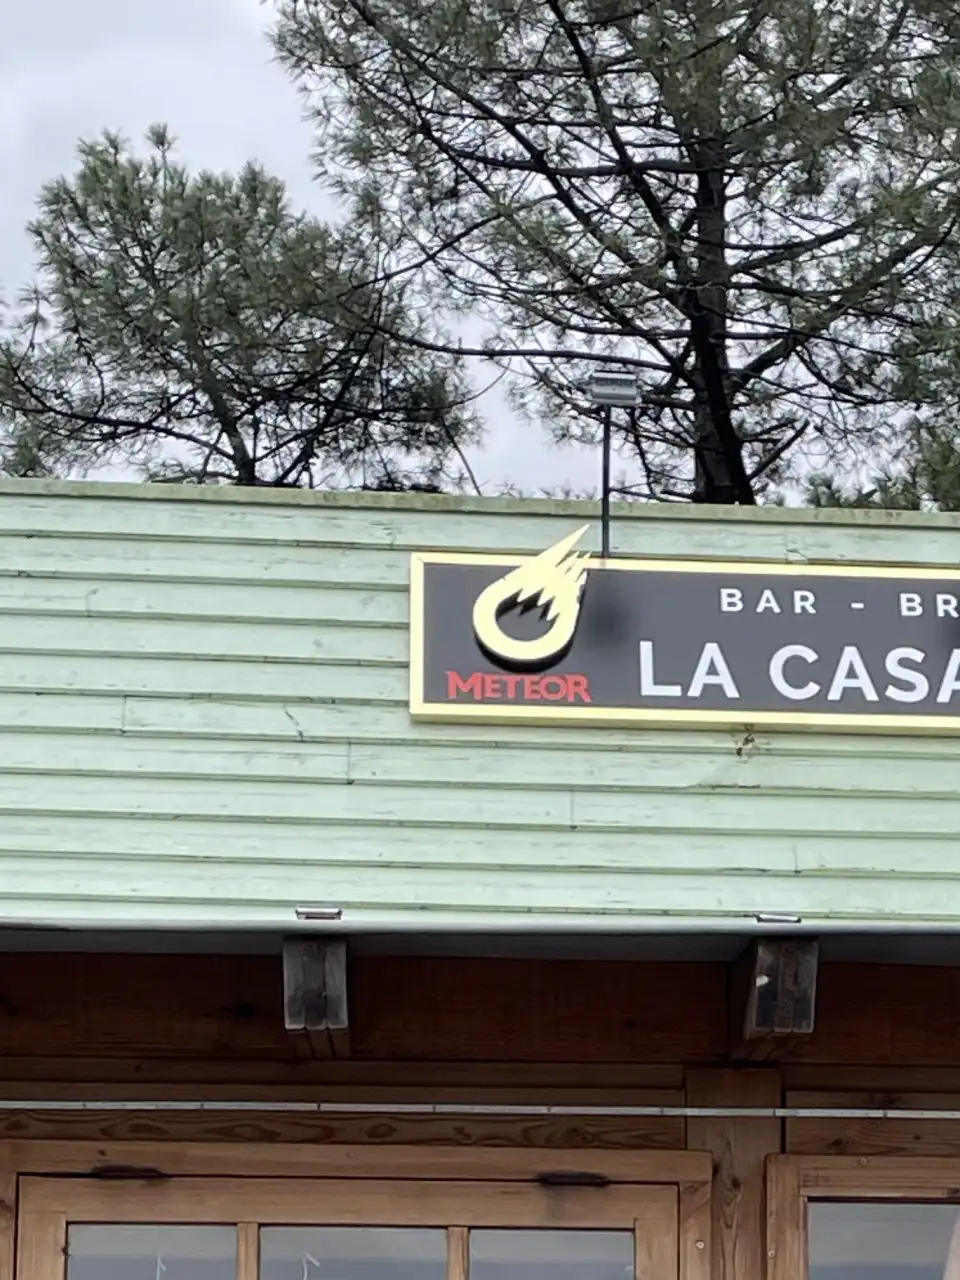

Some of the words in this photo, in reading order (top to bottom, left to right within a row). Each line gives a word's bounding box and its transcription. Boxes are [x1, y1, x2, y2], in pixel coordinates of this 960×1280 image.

[720, 588, 817, 615] BAR
[639, 640, 741, 699] LA
[446, 670, 593, 703] METEOR
